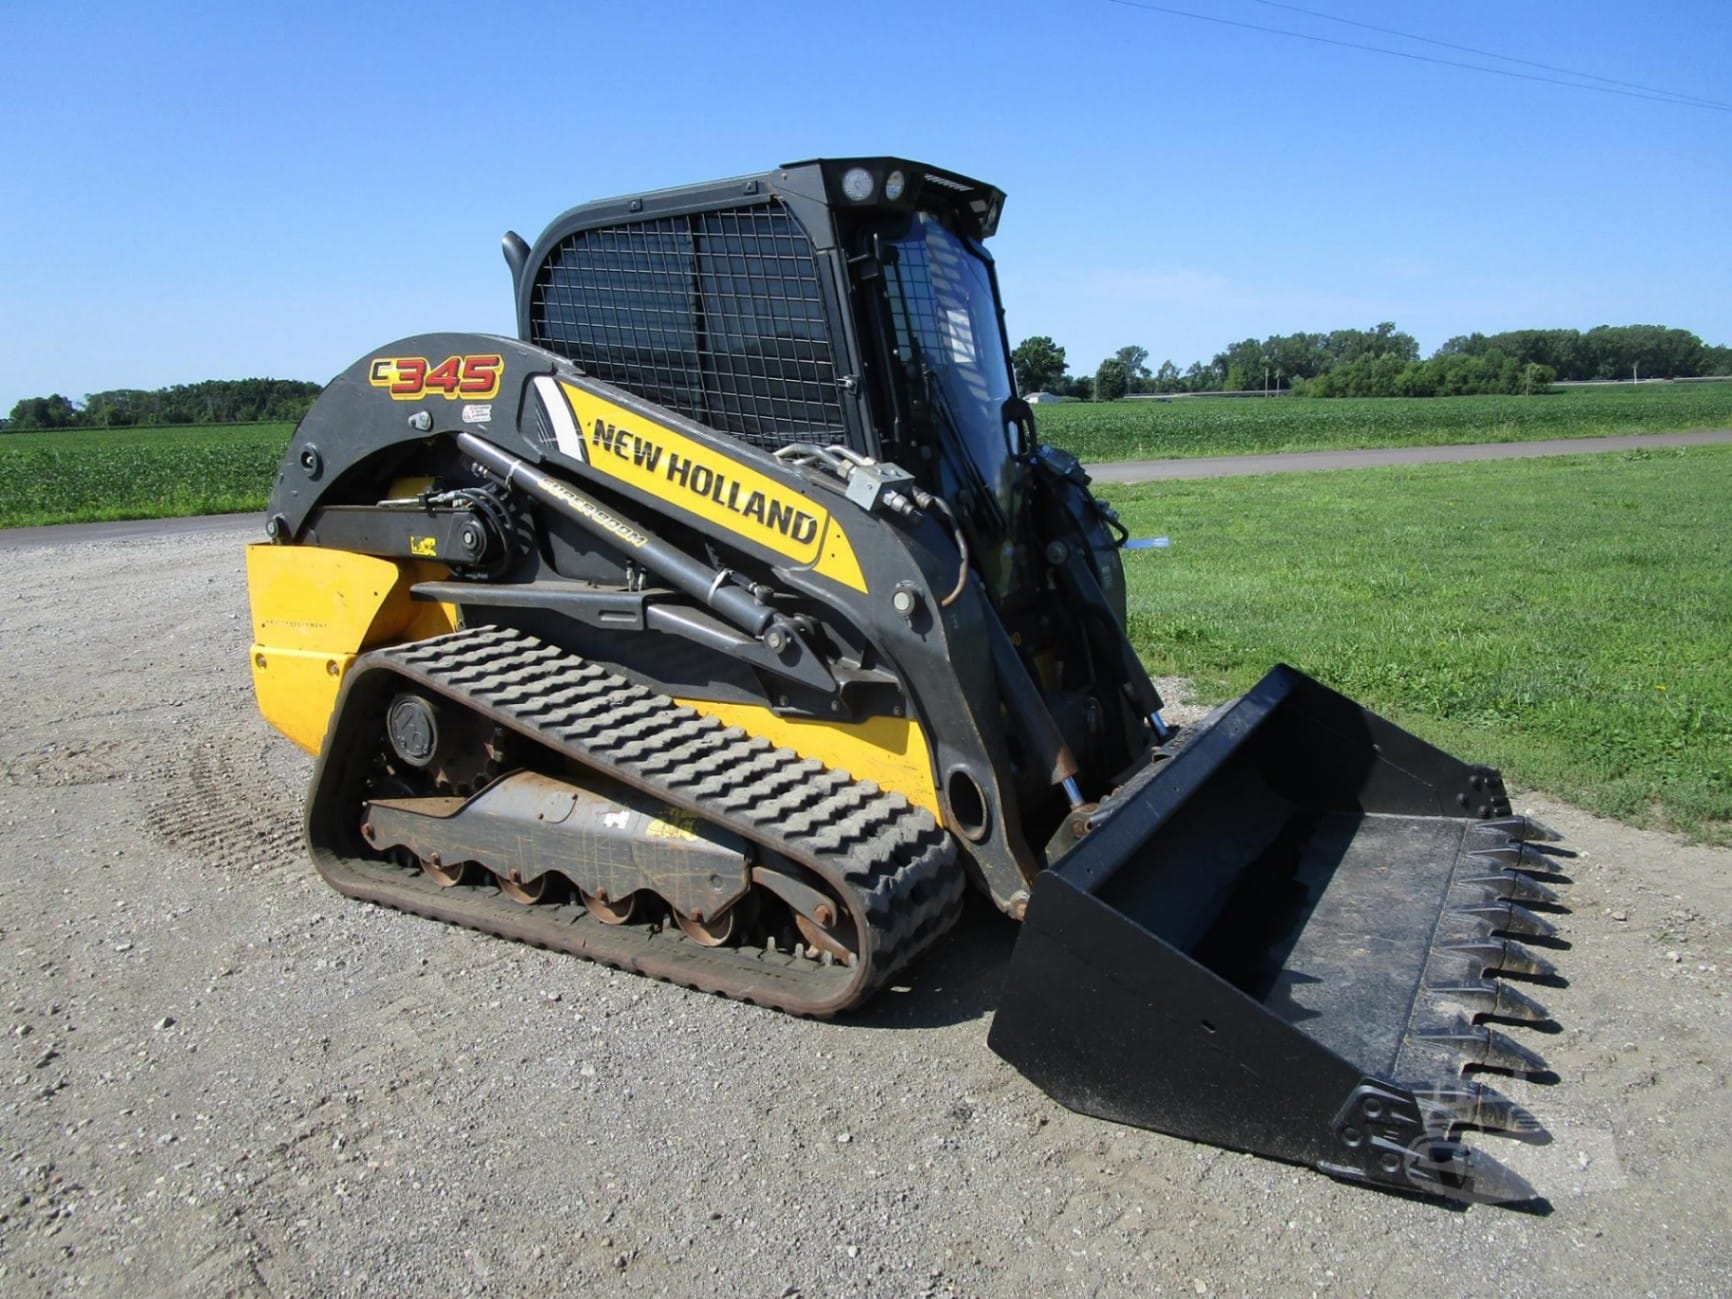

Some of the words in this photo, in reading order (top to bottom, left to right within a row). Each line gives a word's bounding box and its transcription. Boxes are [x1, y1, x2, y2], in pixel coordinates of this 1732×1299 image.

[370, 356, 503, 397] C345
[592, 418, 663, 473] NEW
[666, 453, 818, 545] HOLLAND
